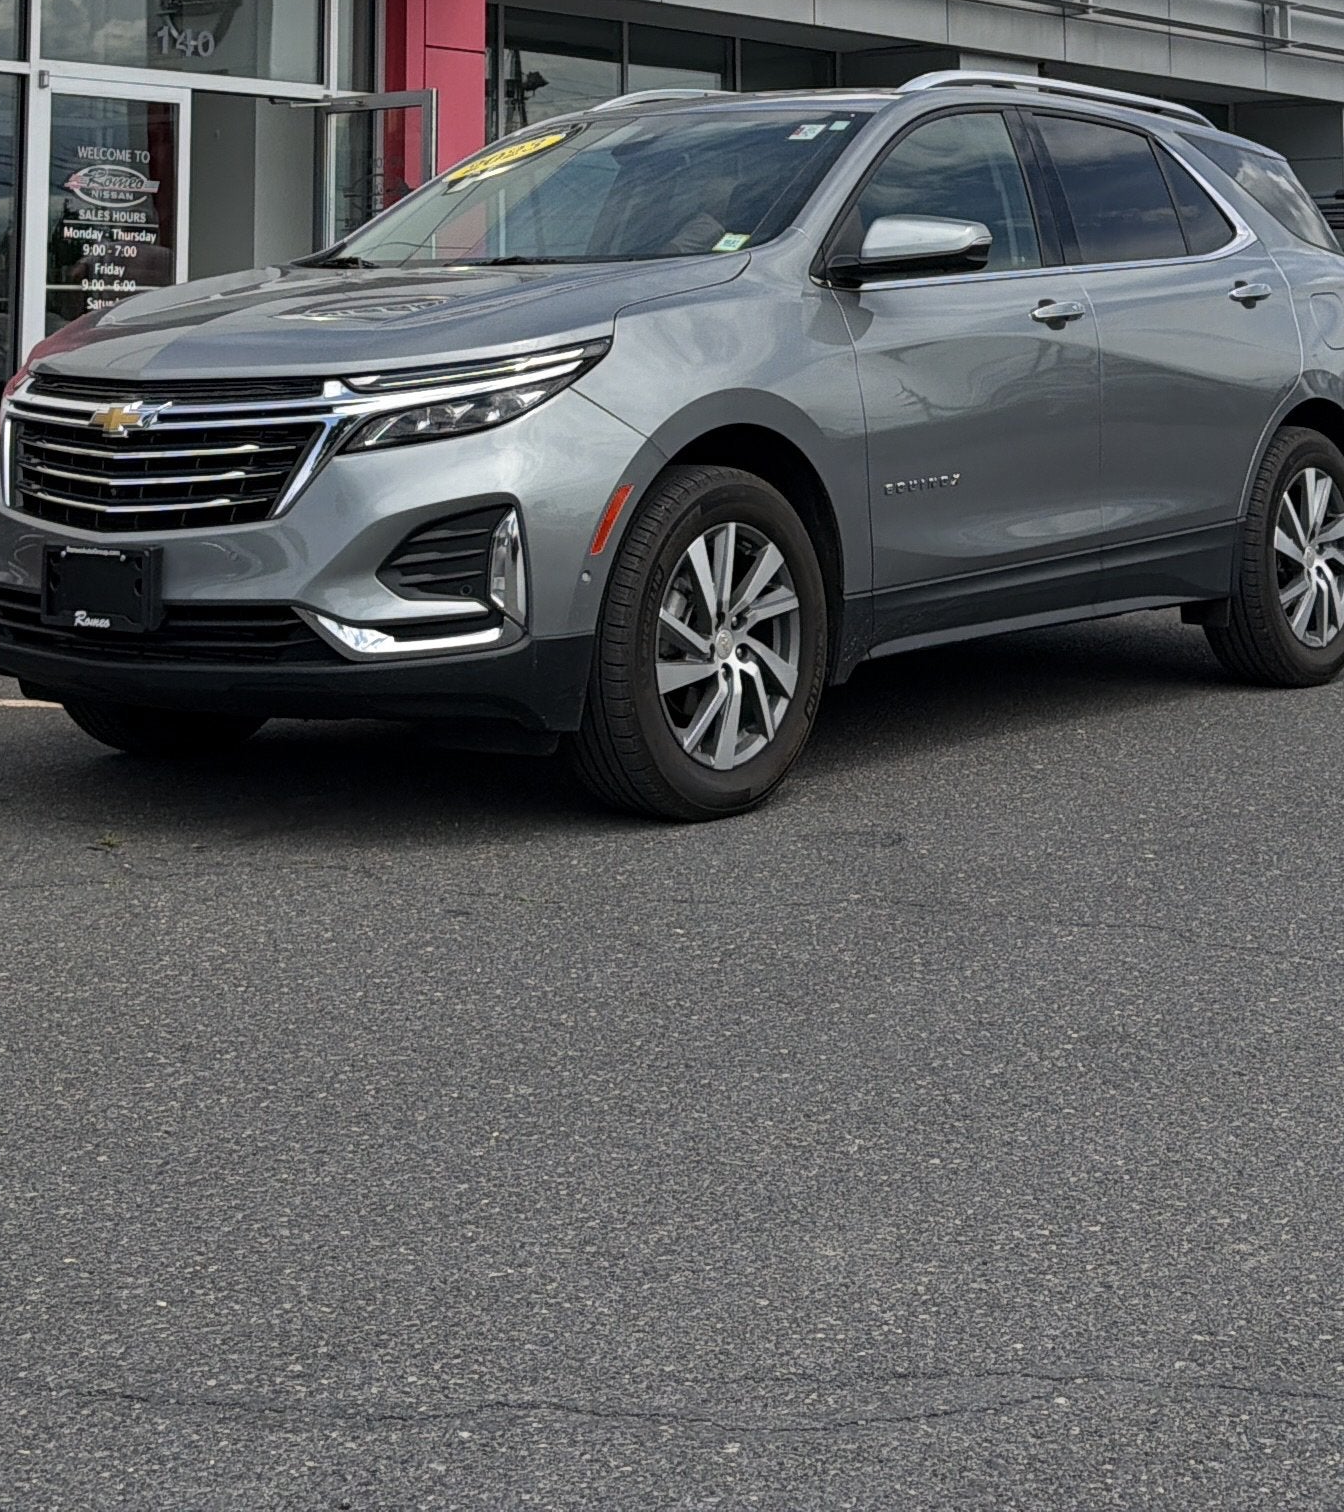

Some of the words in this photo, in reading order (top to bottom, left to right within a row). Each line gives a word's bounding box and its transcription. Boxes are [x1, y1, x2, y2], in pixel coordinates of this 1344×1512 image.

[157, 26, 216, 57] 140
[77, 146, 132, 163] WELCOME
[135, 150, 151, 164] TO
[84, 169, 145, 188] Romeo
[90, 191, 134, 200] NISSAN
[78, 209, 110, 221] SALES
[112, 211, 147, 223] HOURS
[63, 226, 103, 242] Monday
[112, 228, 157, 244] Thursday
[82, 244, 106, 256] 9:00
[114, 245, 137, 258] 7:00
[94, 263, 125, 278] Friday
[81, 279, 105, 291] 9:00
[113, 280, 136, 292] 6:00
[86, 297, 120, 310] Satur
[74, 610, 110, 628] Romeo
